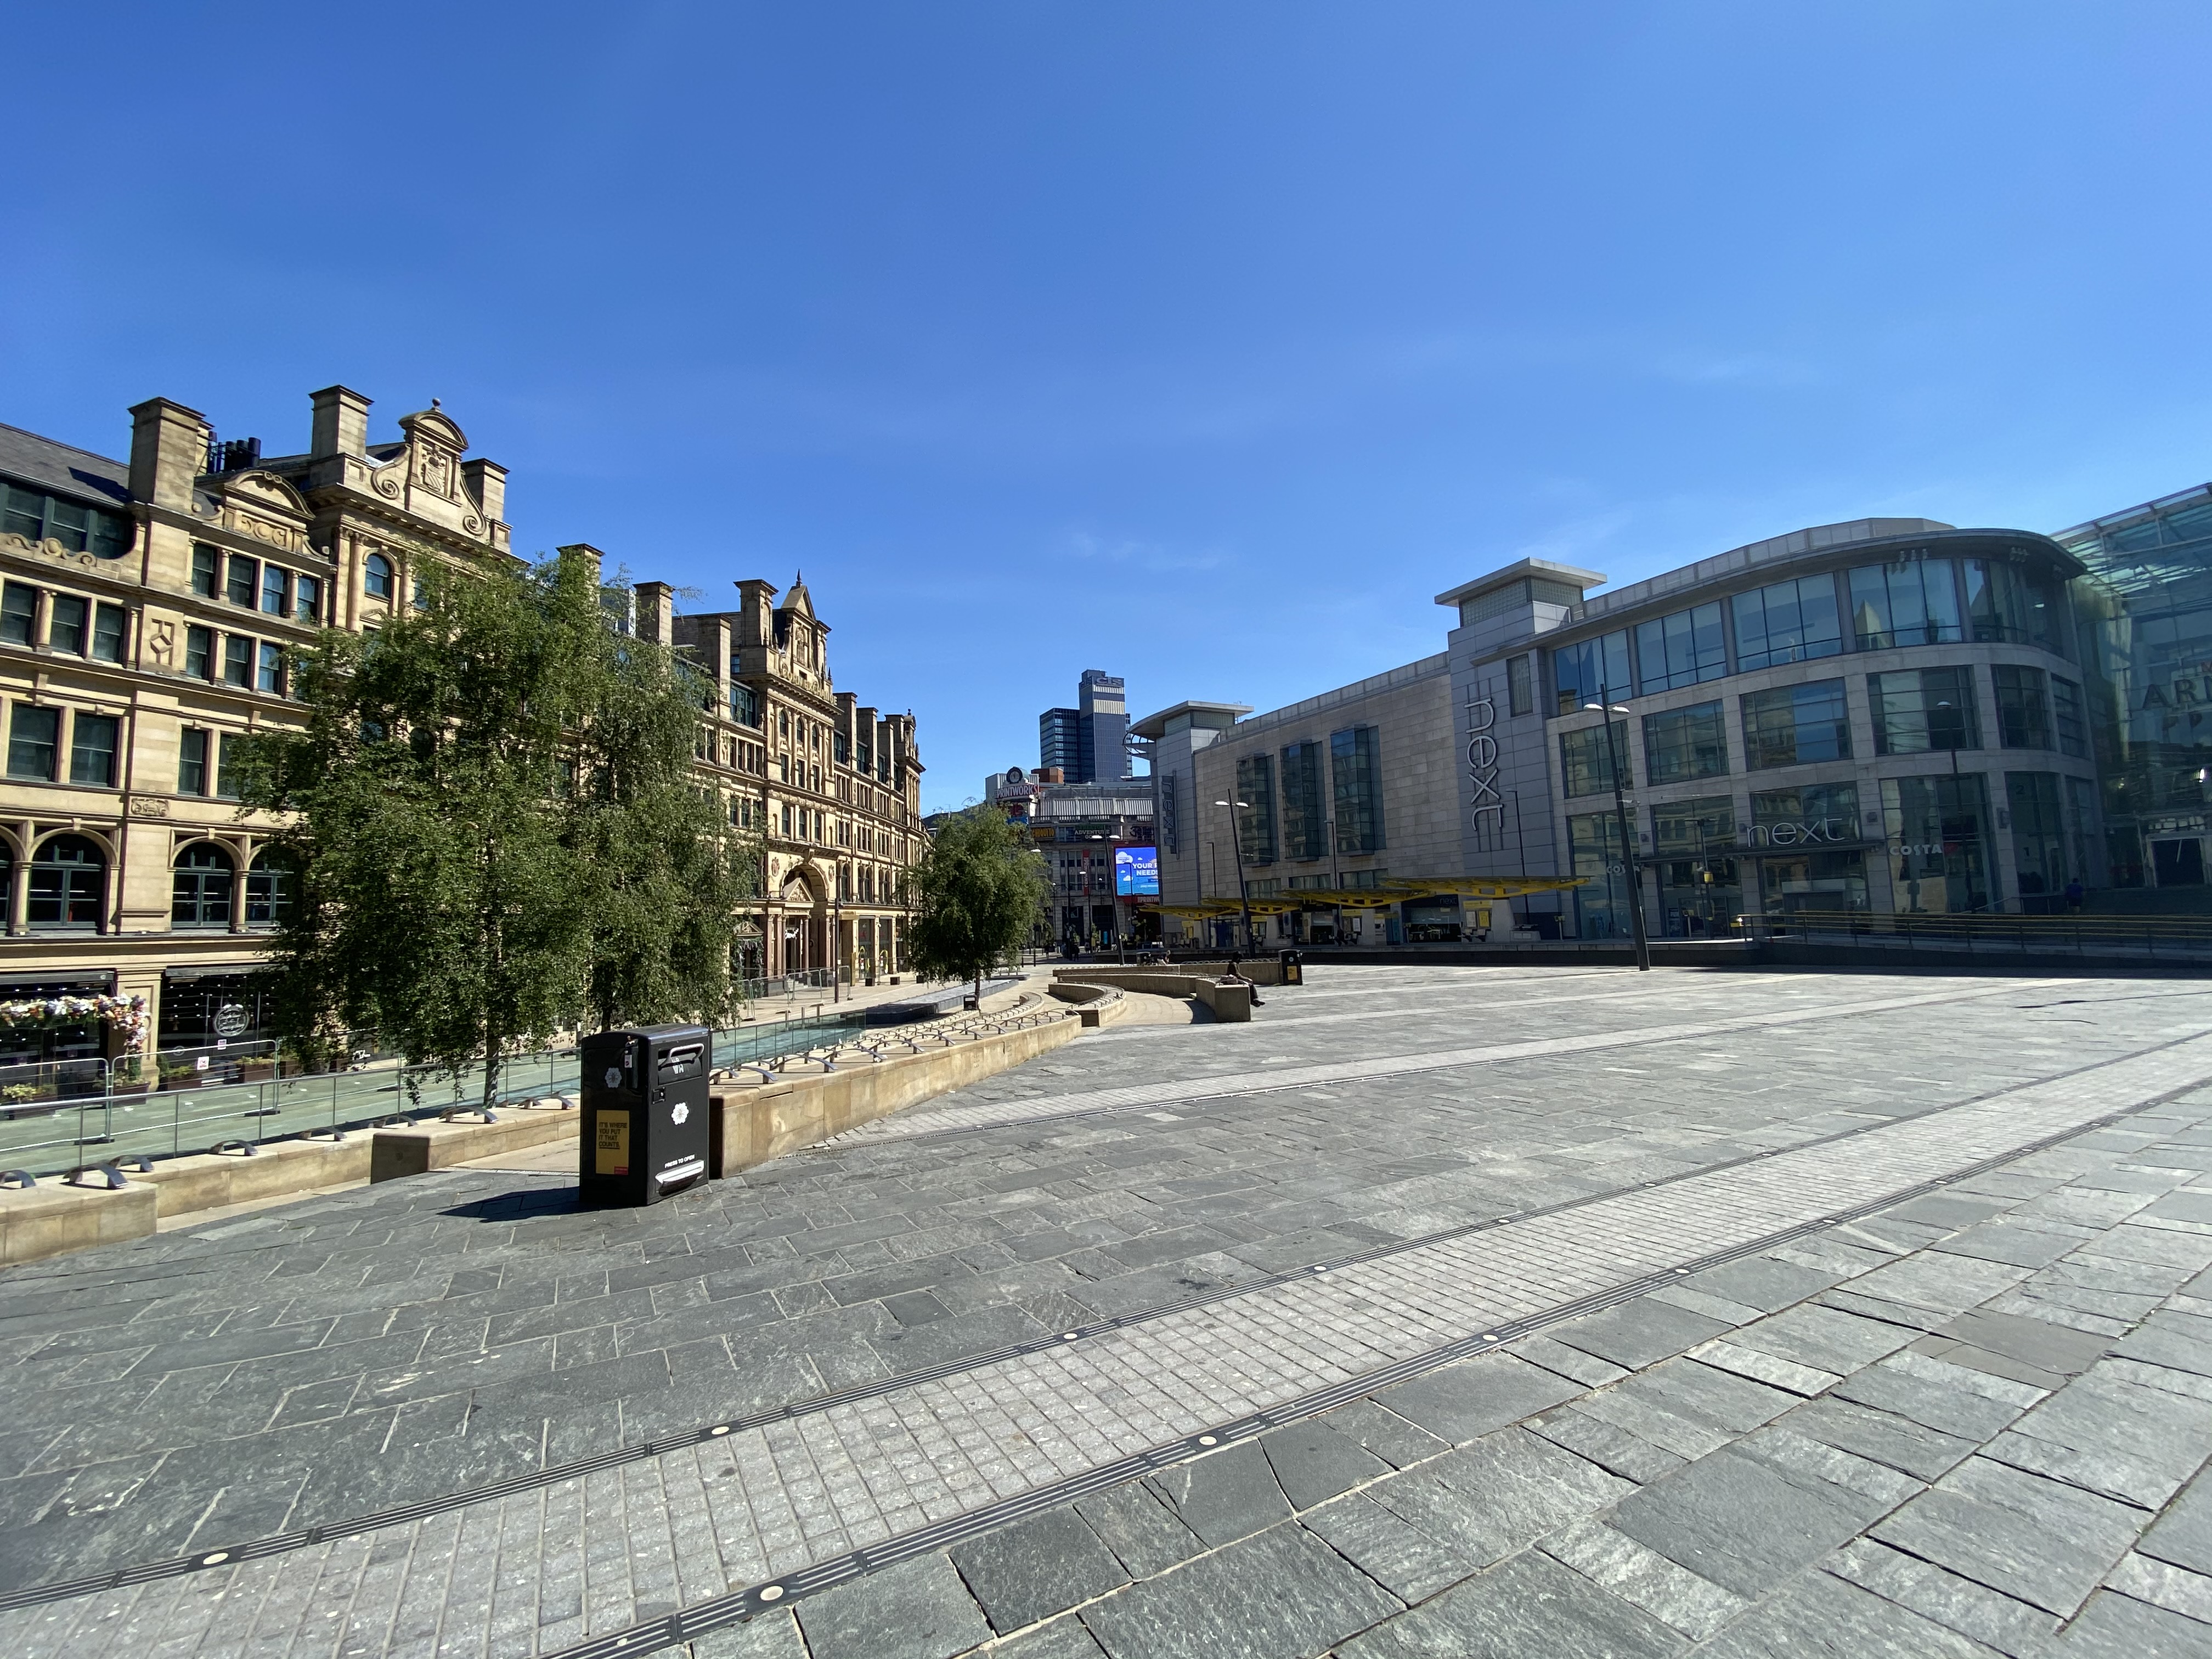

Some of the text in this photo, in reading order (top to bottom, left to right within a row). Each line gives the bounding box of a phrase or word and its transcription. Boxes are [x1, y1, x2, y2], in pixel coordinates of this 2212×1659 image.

[1097, 677, 1122, 686] CIS
[1464, 697, 1503, 832] next
[997, 785, 1038, 798] PRINTWORKS
[1163, 782, 1174, 845] next
[1747, 817, 1846, 848] next
[1889, 844, 1943, 856] COSTA
[1607, 865, 1640, 874] COSA
[664, 1160, 678, 1168] PRESS
